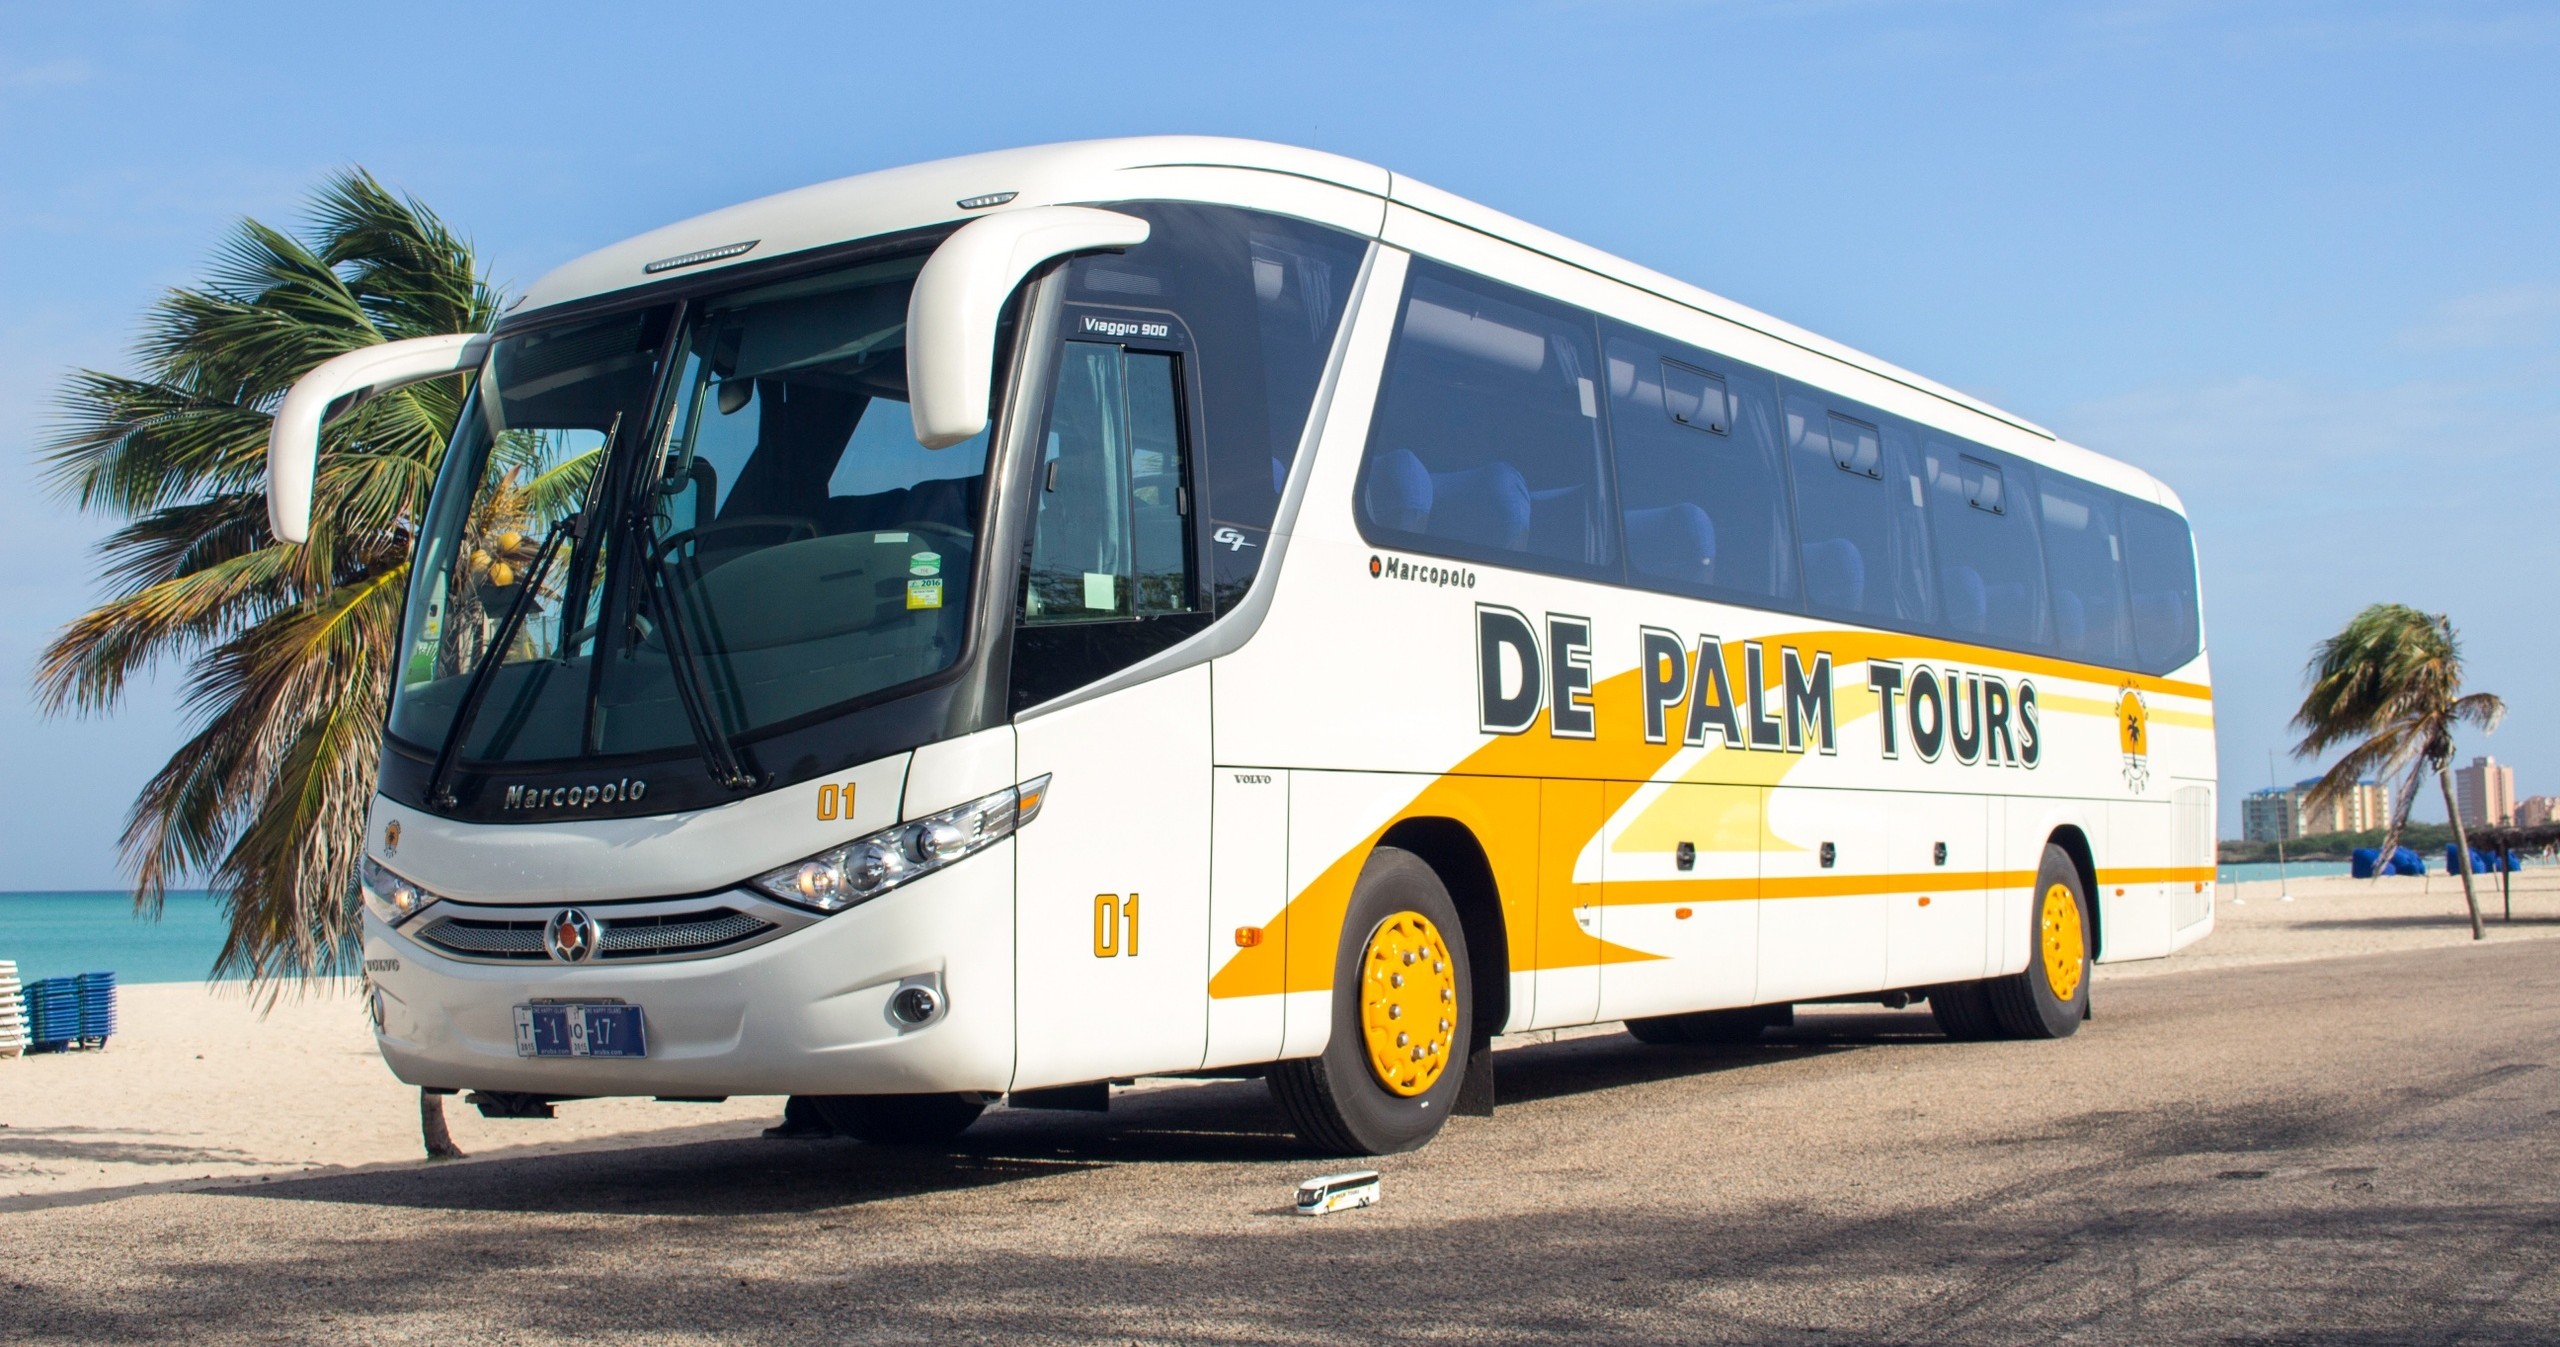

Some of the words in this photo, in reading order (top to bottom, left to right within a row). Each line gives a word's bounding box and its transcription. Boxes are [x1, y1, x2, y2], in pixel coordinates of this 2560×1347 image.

[1085, 318, 1138, 336] Viaggio
[1142, 324, 1168, 337] 900
[921, 579, 941, 587] 2016
[1385, 556, 1476, 589] Marcopolo
[1475, 601, 1596, 741] DE
[1640, 624, 1838, 756] PALM
[1867, 658, 2042, 770] TOURS
[504, 778, 645, 810] Marcopolo
[1233, 774, 1272, 784] VOLVO
[817, 782, 856, 821] 01
[1094, 893, 1139, 958] 01
[366, 958, 400, 972] VOLVO
